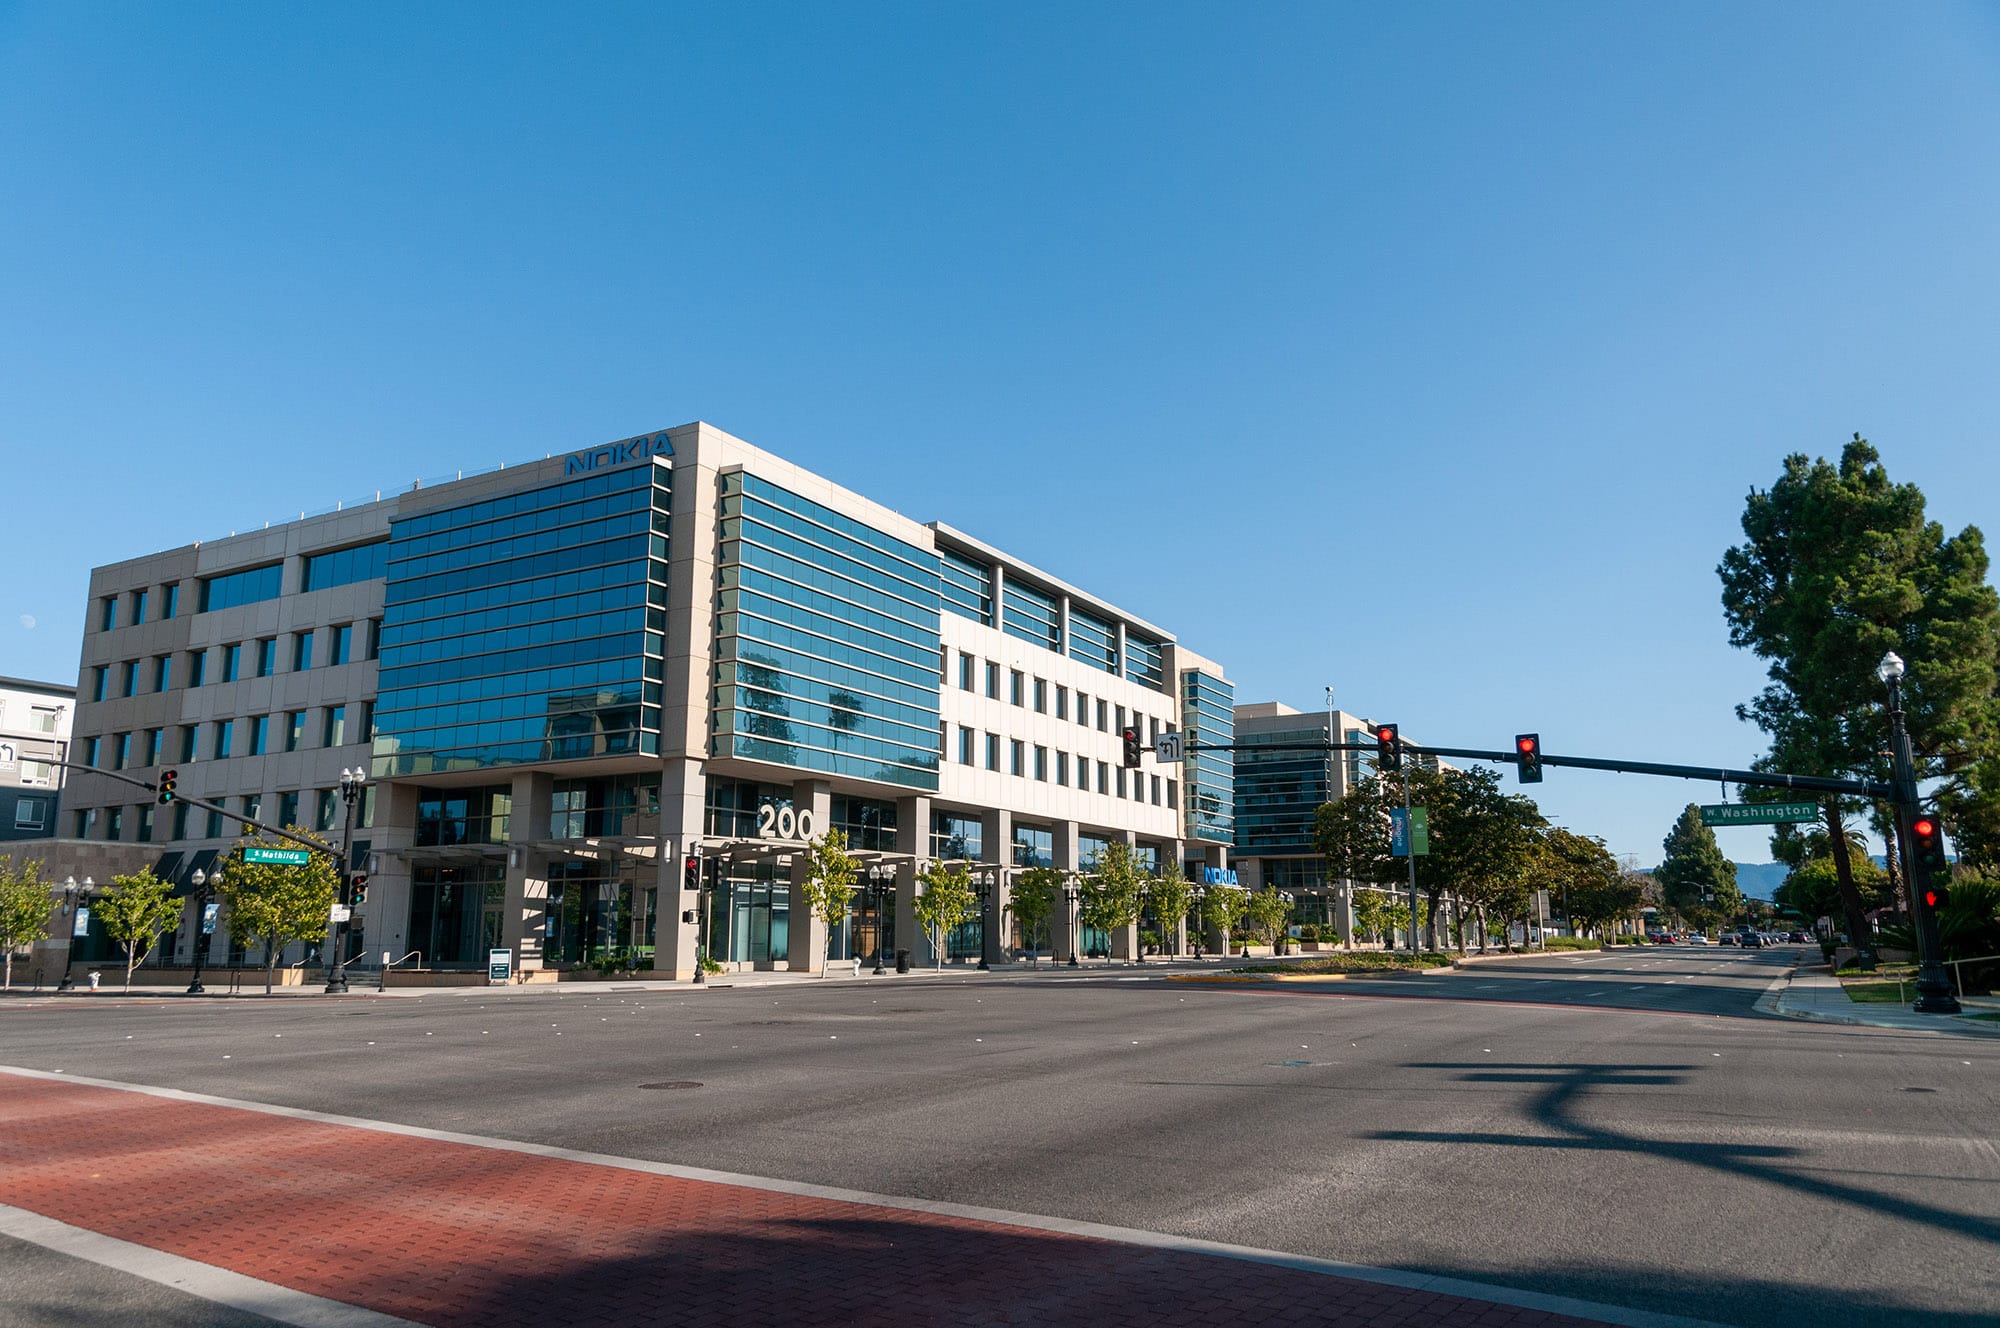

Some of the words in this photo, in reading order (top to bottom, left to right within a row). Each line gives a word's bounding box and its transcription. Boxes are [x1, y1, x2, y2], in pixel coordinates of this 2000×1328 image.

[564, 433, 675, 477] NOKIA
[1721, 806, 1810, 818] Washington
[760, 804, 814, 841] 200
[262, 851, 300, 860] Mathilda
[1204, 866, 1239, 886] NOKIA
